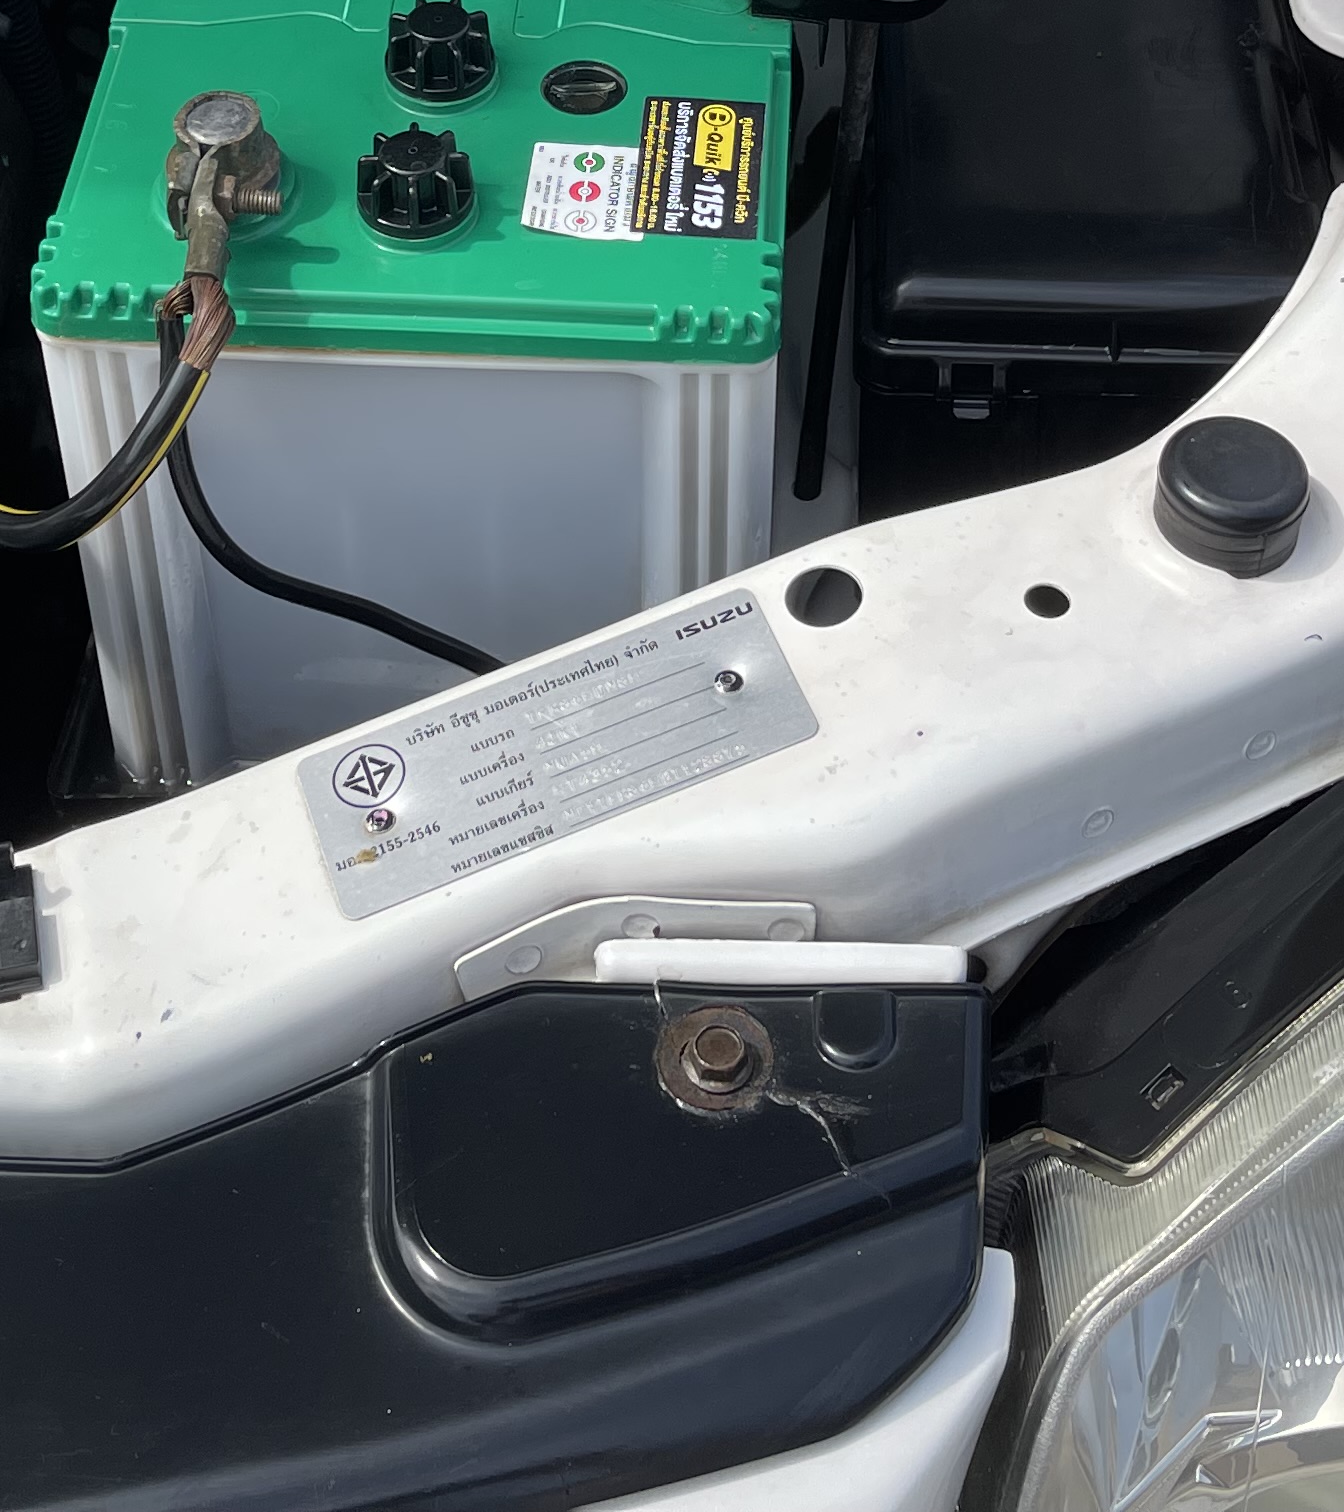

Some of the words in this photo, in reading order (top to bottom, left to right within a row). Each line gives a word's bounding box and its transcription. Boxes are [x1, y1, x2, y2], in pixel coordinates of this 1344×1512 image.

[703, 109, 729, 165] B-Quik
[608, 156, 624, 206] INDICATOR
[603, 208, 617, 233] SIGN
[692, 183, 725, 228] 1153
[676, 602, 753, 640] ISUZU
[406, 722, 445, 745] บริษัท
[624, 639, 658, 658] จำกัด
[471, 730, 515, 752] แบบรถ
[460, 752, 524, 785] แบบเครื่อง
[476, 770, 533, 806] แบบเกียร์
[448, 799, 544, 845] หมายเลขเครื่อง
